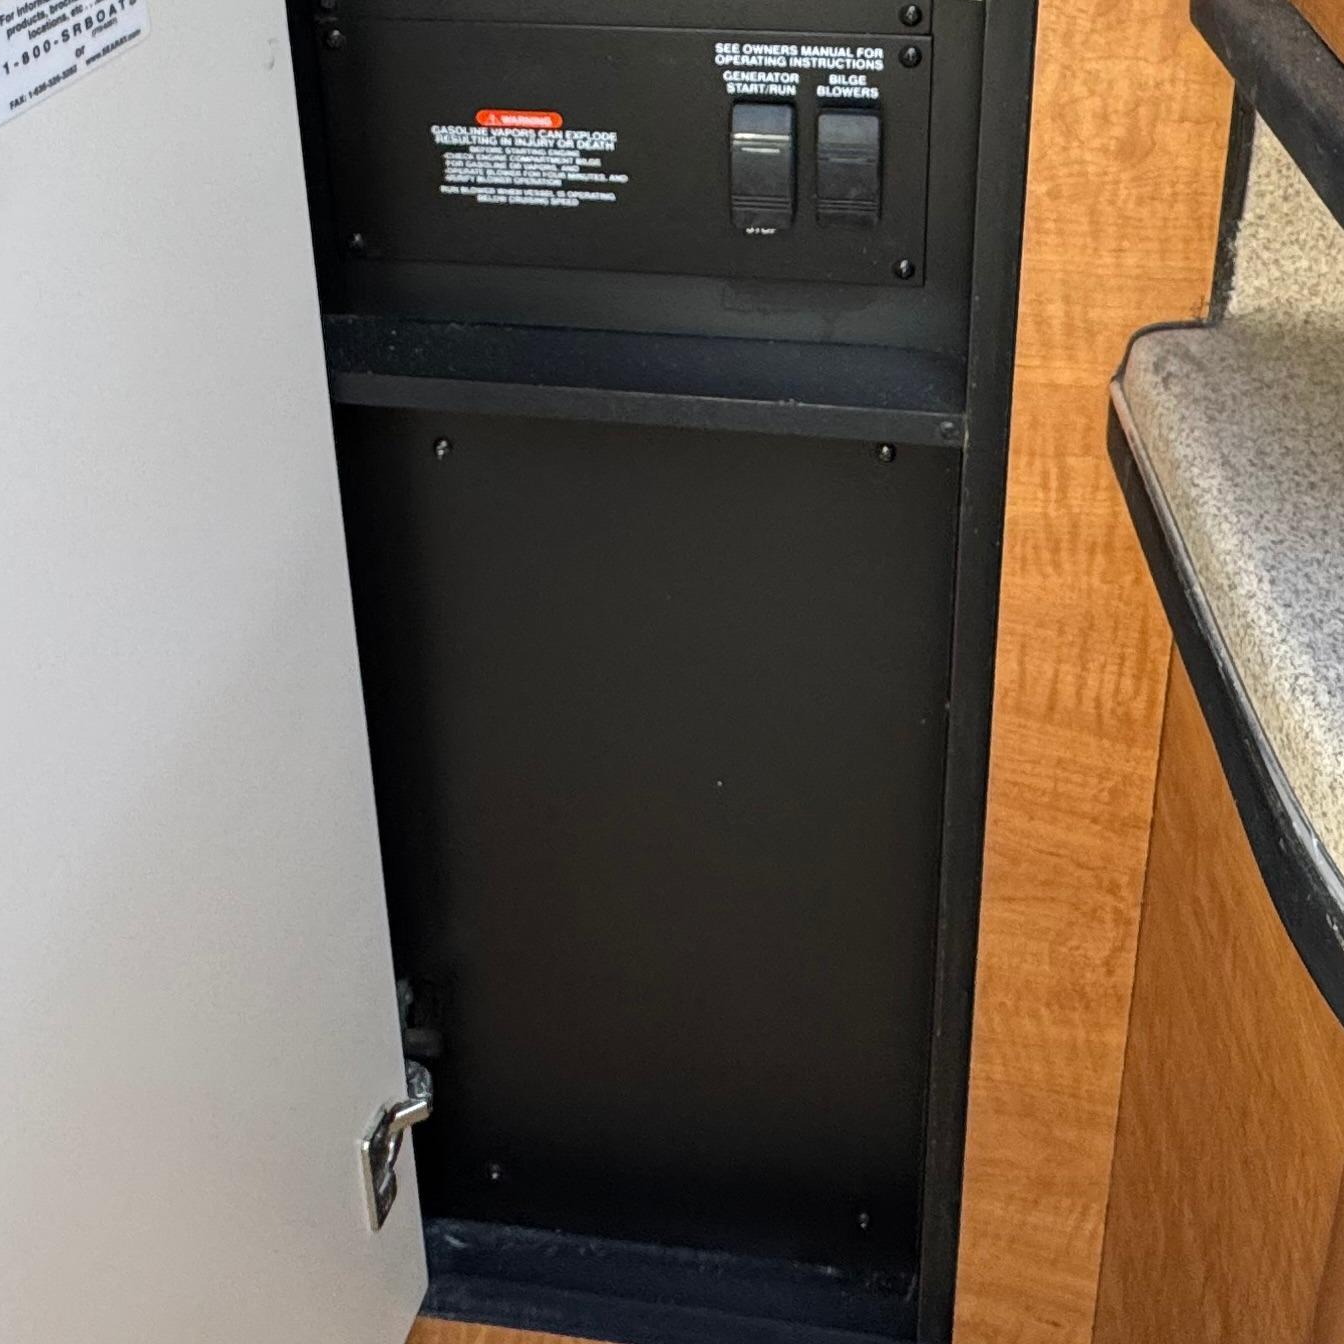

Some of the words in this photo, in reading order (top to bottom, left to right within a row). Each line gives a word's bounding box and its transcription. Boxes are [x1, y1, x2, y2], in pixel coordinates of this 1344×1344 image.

[0, 10, 15, 26] For
[6, 10, 48, 40] products,
[28, 14, 70, 40] locations,
[74, 45, 86, 58] or
[714, 42, 740, 54] SEE
[742, 43, 799, 56] OWNERS
[800, 45, 854, 58] MANUAL
[856, 47, 884, 59] FOR
[714, 54, 787, 67] OPERATING
[789, 56, 884, 71] INSTRUCTIONS
[722, 70, 800, 84] GENERATOR
[828, 74, 867, 86] BILGE
[726, 82, 796, 96] START/RUN
[816, 85, 880, 99] BLOWERS
[500, 114, 553, 126] WARNING
[430, 124, 488, 137] GASOLINE
[490, 127, 537, 138] VAPORS
[538, 128, 564, 140] CAN
[565, 130, 618, 142] EXPLODE
[435, 134, 498, 146] RESULTING
[500, 137, 513, 147] IN
[514, 137, 554, 148] INJURY
[557, 139, 575, 150] OR
[576, 140, 615, 151] DEATH
